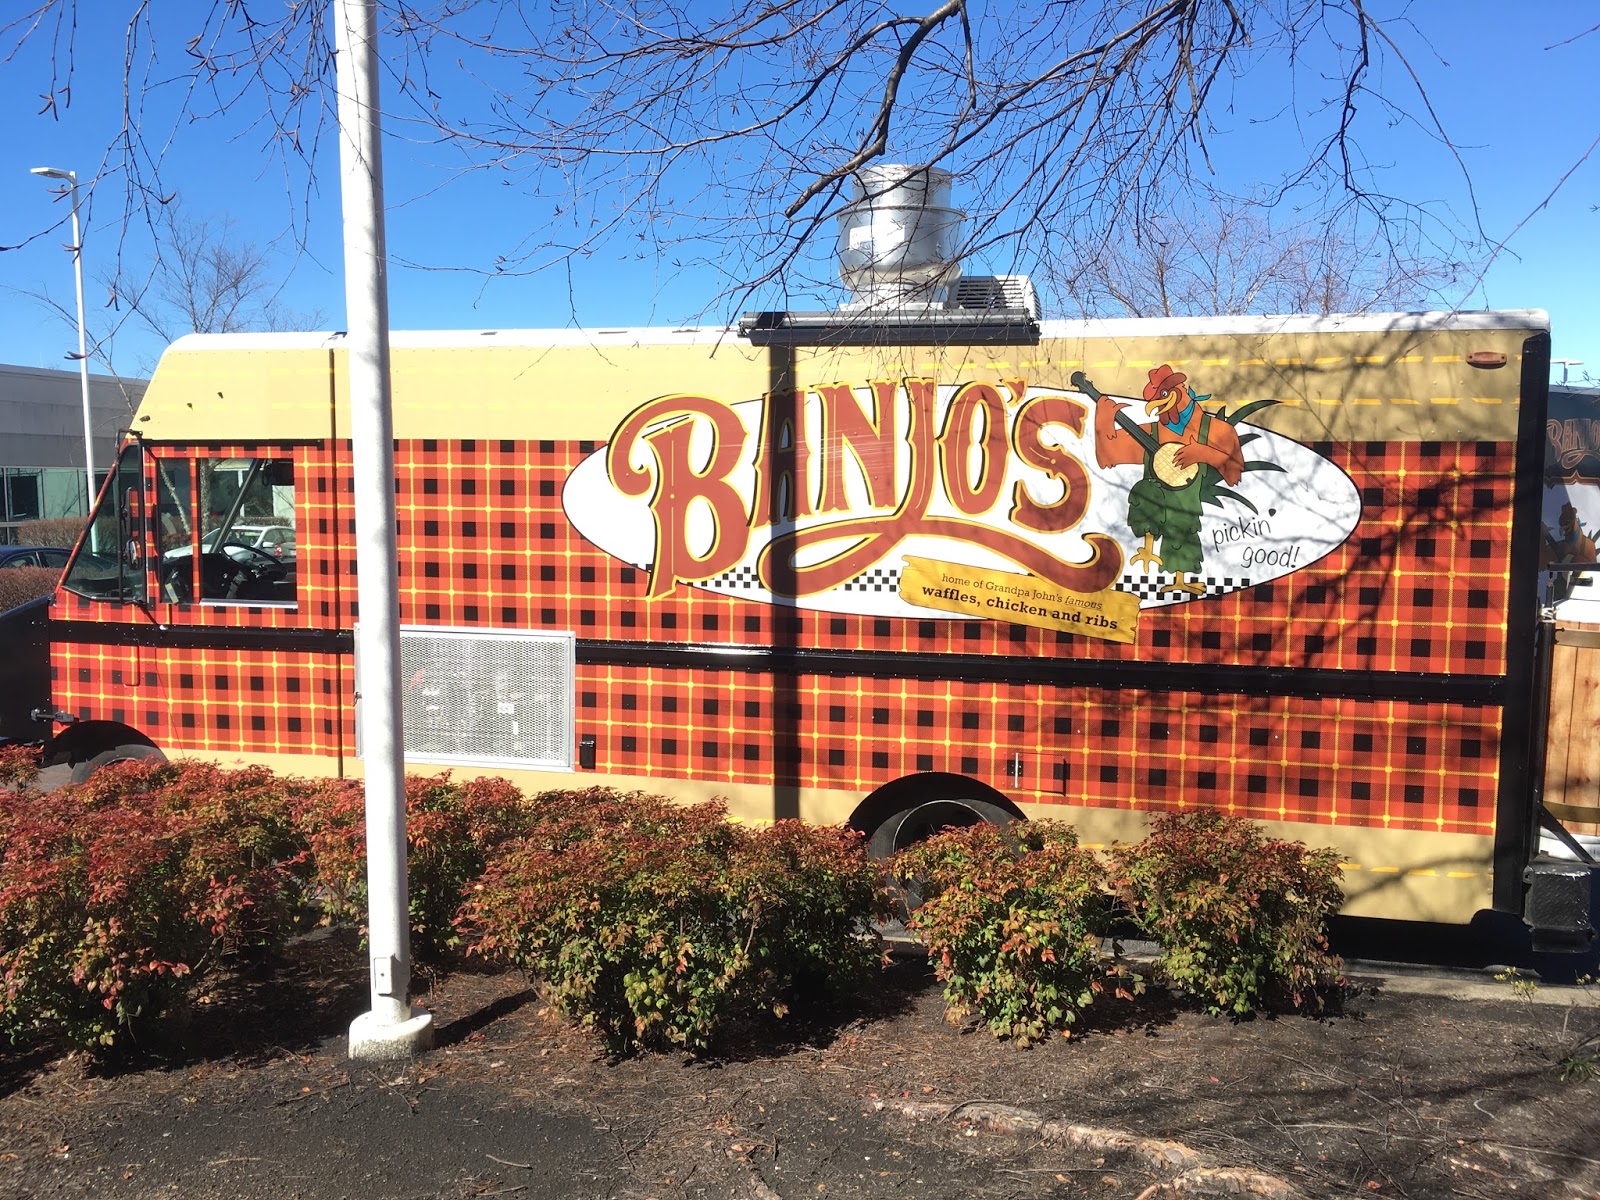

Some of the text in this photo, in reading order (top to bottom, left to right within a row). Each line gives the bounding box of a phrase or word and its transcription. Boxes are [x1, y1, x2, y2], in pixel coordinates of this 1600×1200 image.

[607, 377, 1124, 601] BANJO'S
[1240, 545, 1300, 568] good!
[922, 586, 1118, 630] waffles, chicken and ribs
[943, 573, 1102, 610] home of Grandpa John's famous
